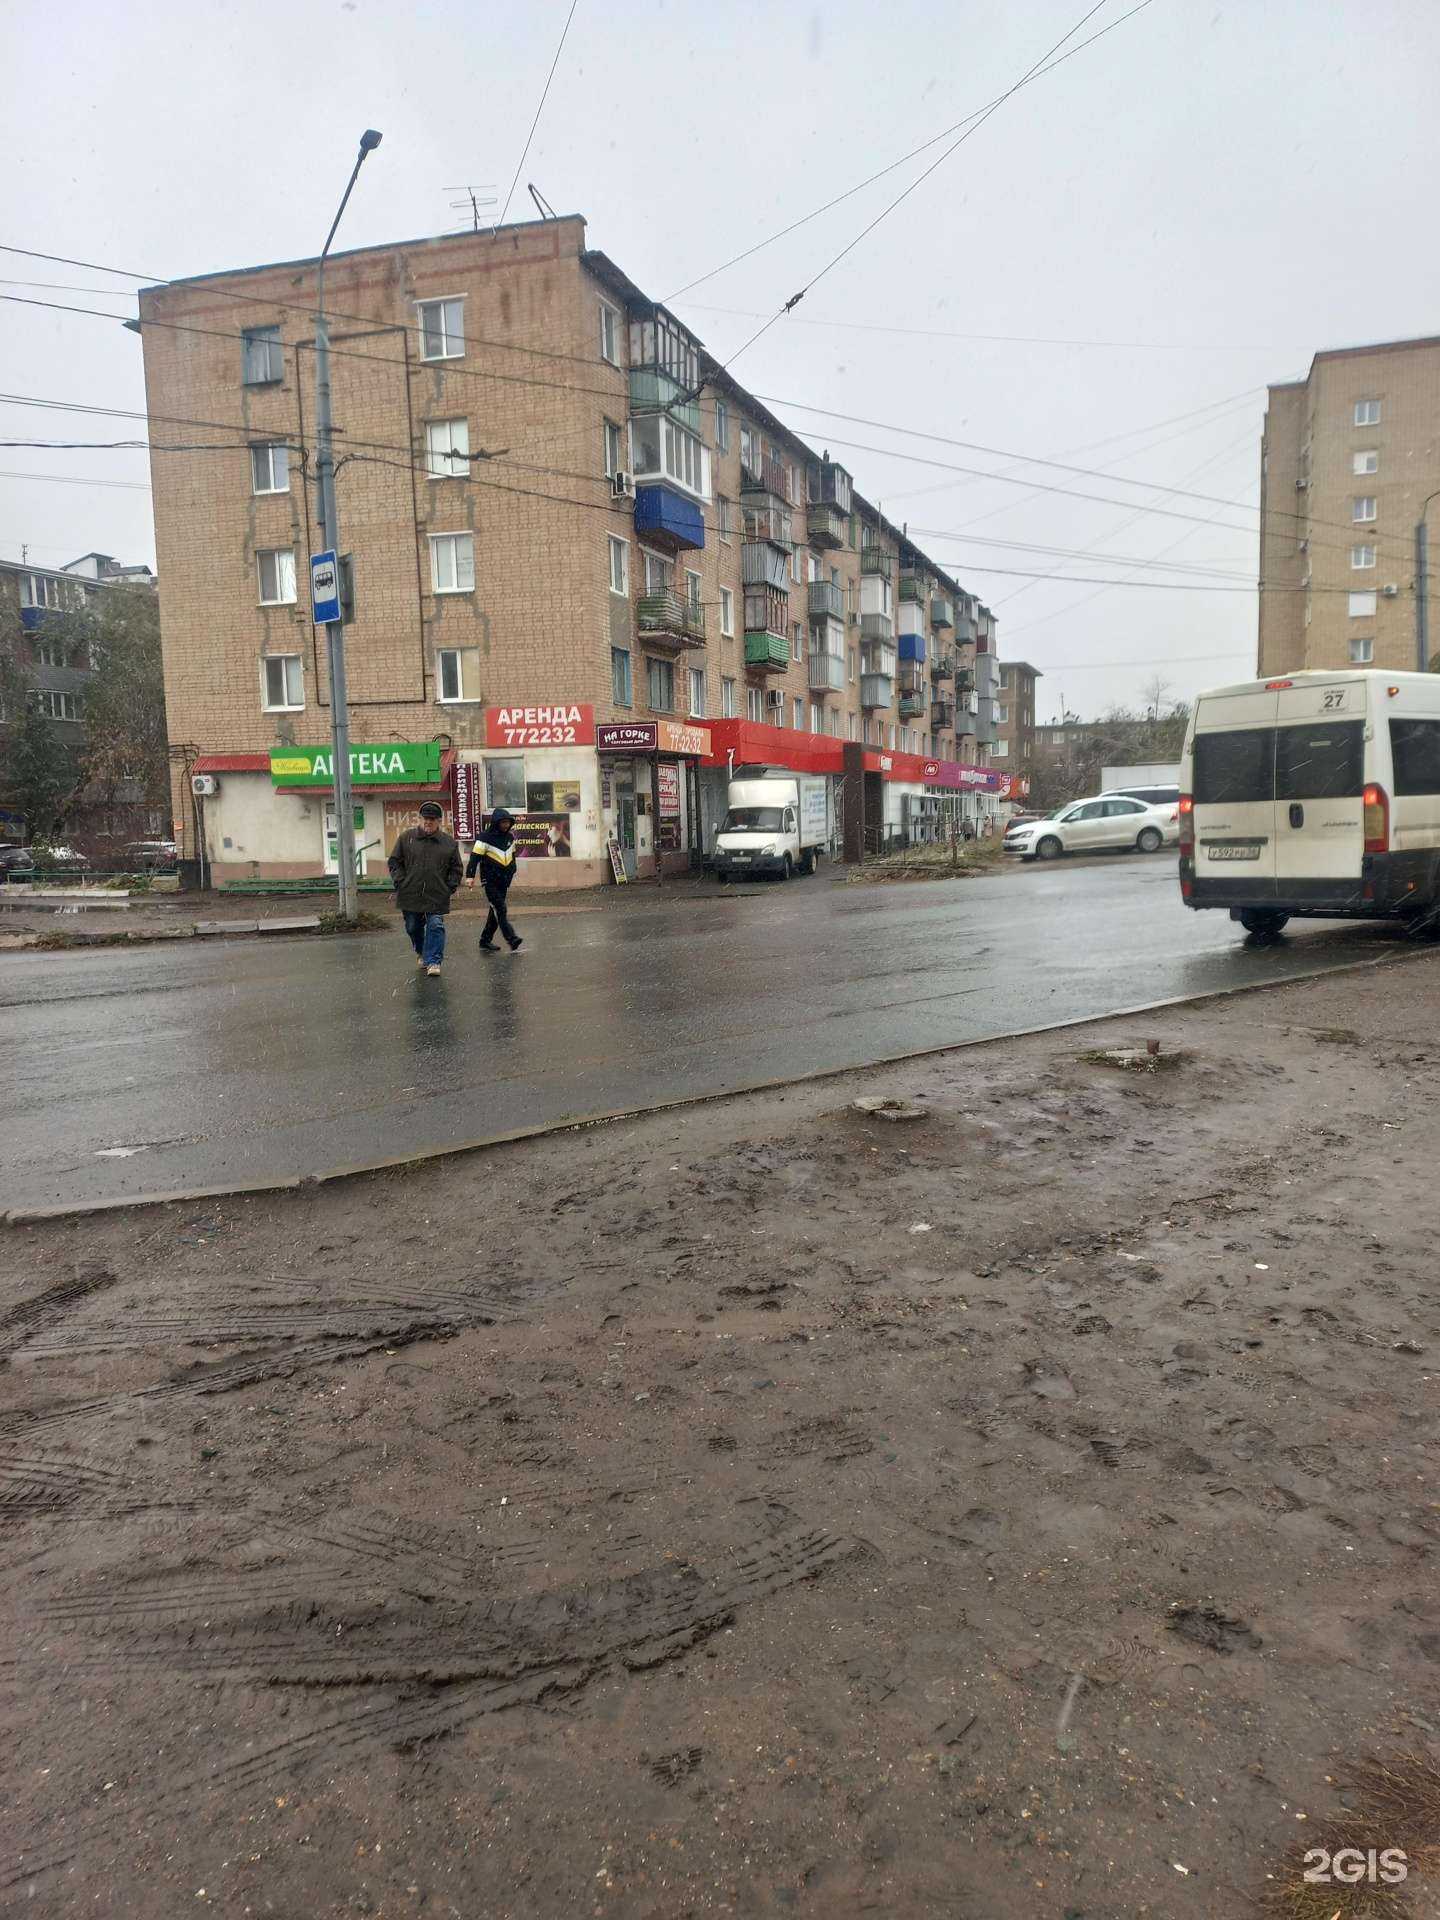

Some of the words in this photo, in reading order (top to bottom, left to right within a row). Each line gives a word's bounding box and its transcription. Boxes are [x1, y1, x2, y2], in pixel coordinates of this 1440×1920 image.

[1325, 694, 1344, 708] 27
[497, 706, 582, 725] АРЕНДА
[504, 726, 576, 745] 772232
[603, 731, 618, 743] НА
[619, 729, 651, 742] ГОРКЕ
[670, 734, 701, 754] 77-22-32
[456, 763, 469, 832] ПАРИКМАХЕРСКАЯ
